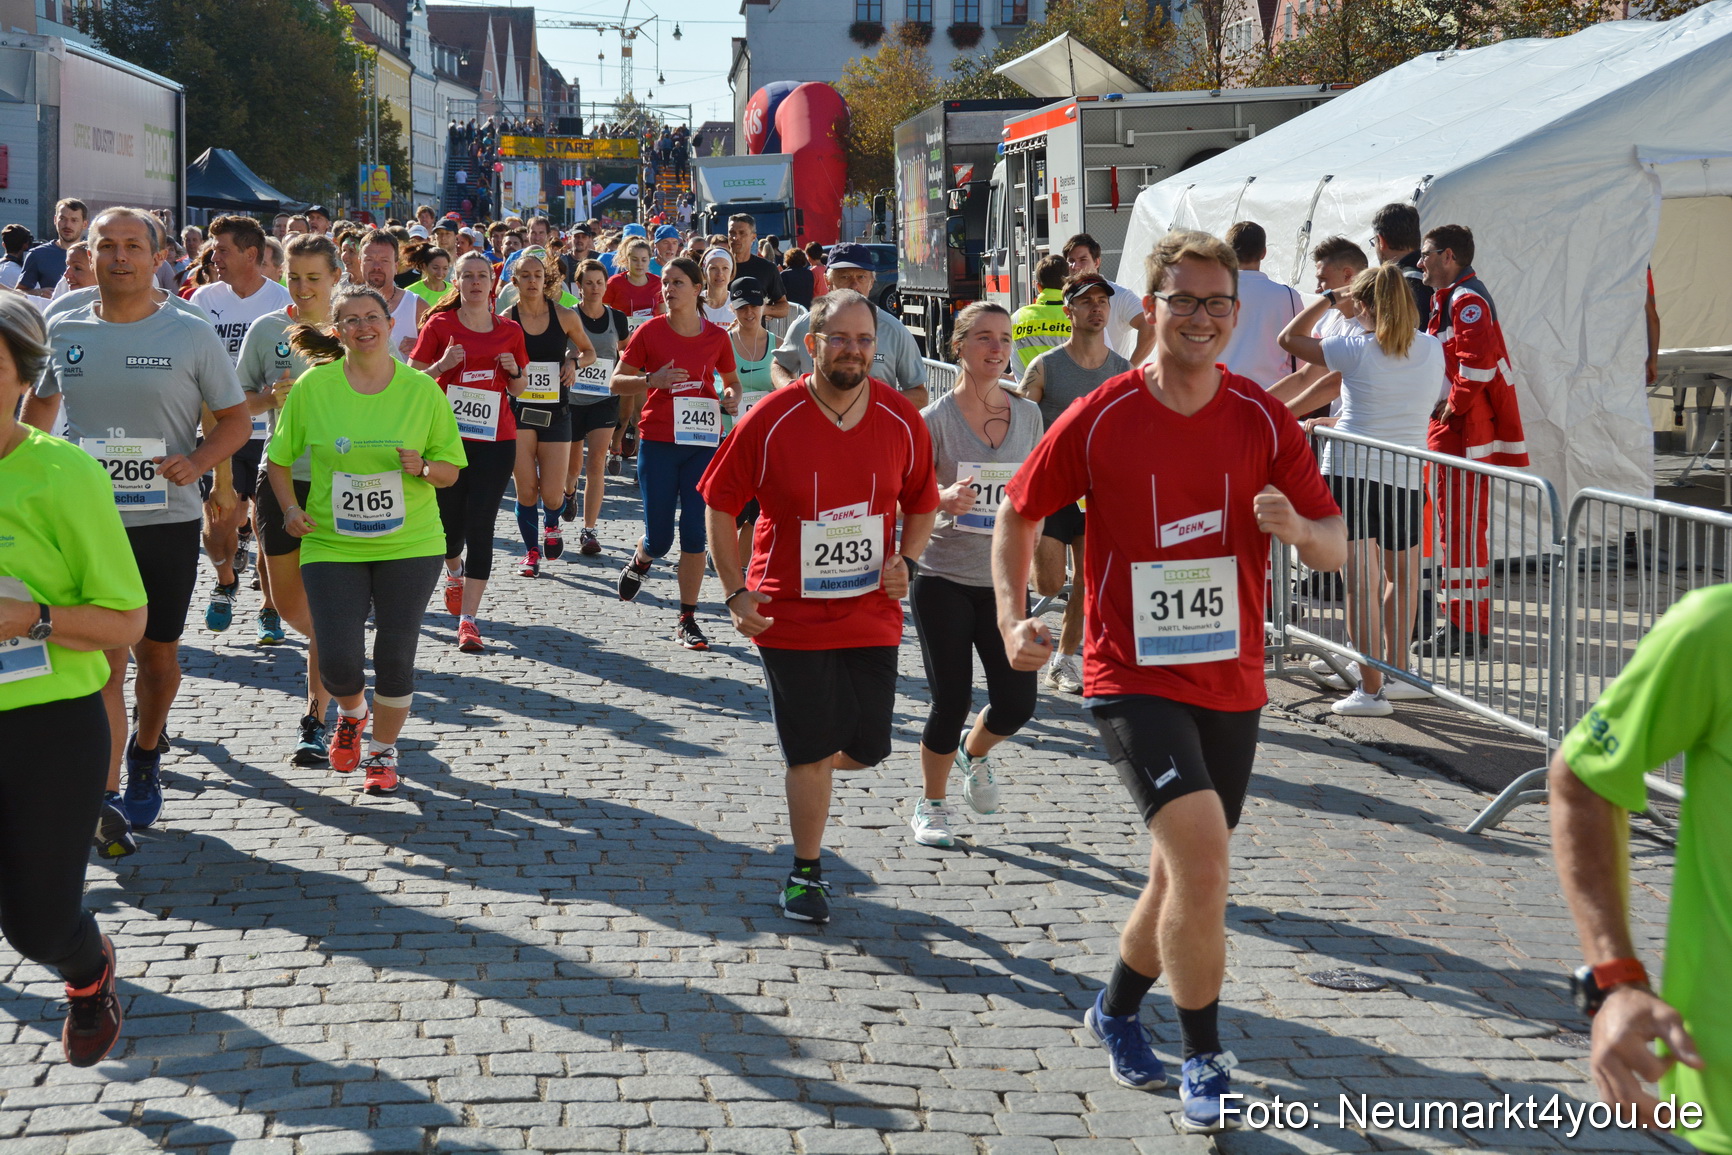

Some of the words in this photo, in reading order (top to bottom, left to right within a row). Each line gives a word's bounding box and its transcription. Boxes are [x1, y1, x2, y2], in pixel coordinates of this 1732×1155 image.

[73, 122, 91, 150] OFFICE
[92, 126, 115, 155] INDUSTRY
[116, 132, 134, 158] LOUNGE
[144, 126, 175, 181] BOCK
[546, 141, 594, 154] START
[724, 178, 766, 187] BOCK
[215, 323, 252, 338] NISH
[1016, 322, 1072, 335] Org.-Leite
[126, 356, 172, 367] BOCK
[578, 366, 606, 380] 2624
[463, 391, 486, 399] BOCK
[453, 400, 491, 419] 2460
[682, 410, 715, 426] 2443
[105, 445, 142, 454] BOCK
[981, 470, 1012, 478] BOCK
[352, 478, 381, 488] BOCK
[114, 493, 145, 503] schda
[342, 490, 393, 512] 2165
[832, 509, 855, 521] DEHN
[353, 522, 386, 531] Claudia
[826, 524, 862, 537] BOCK
[1178, 520, 1204, 536] DEHN
[814, 538, 873, 567] 2433
[838, 566, 863, 574] Neumarkt
[1164, 567, 1211, 581] BOCK
[820, 577, 867, 590] Alexander
[1150, 586, 1224, 621] 3145
[1182, 623, 1212, 631] Neumarkt
